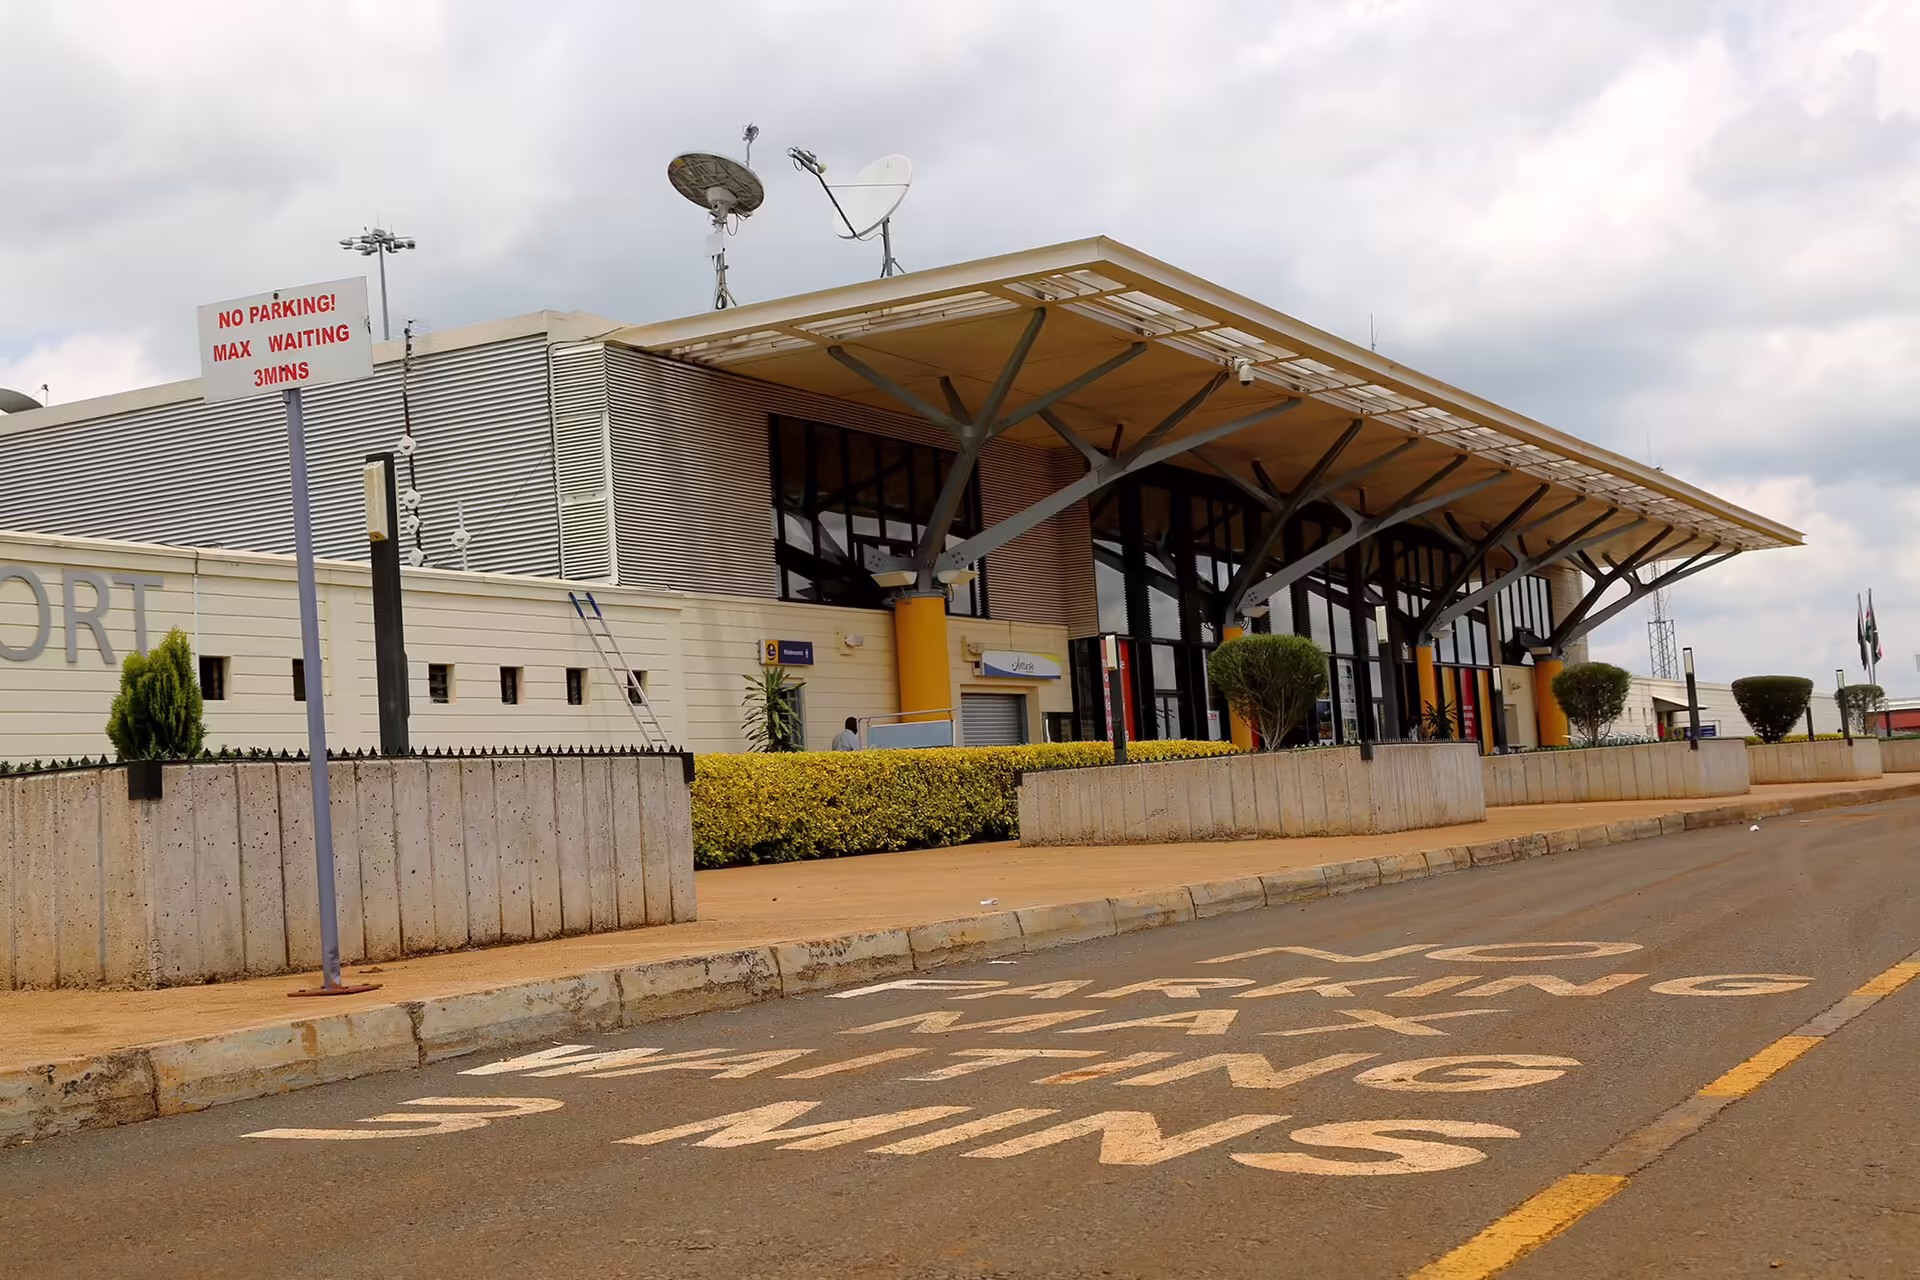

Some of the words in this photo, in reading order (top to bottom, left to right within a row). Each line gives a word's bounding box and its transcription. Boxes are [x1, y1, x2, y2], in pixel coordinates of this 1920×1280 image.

[218, 309, 244, 329] NO
[249, 293, 336, 324] PARKING!
[213, 340, 252, 362] MAX
[268, 324, 350, 352] WAITING
[253, 361, 310, 387] 3MINS
[1195, 941, 1643, 964] NO
[824, 973, 1815, 999] PARKING
[839, 1008, 1510, 1037] MAX
[457, 1044, 1582, 1092] WAITING
[240, 1096, 565, 1140] 3
[611, 1100, 1521, 1177] MINS
